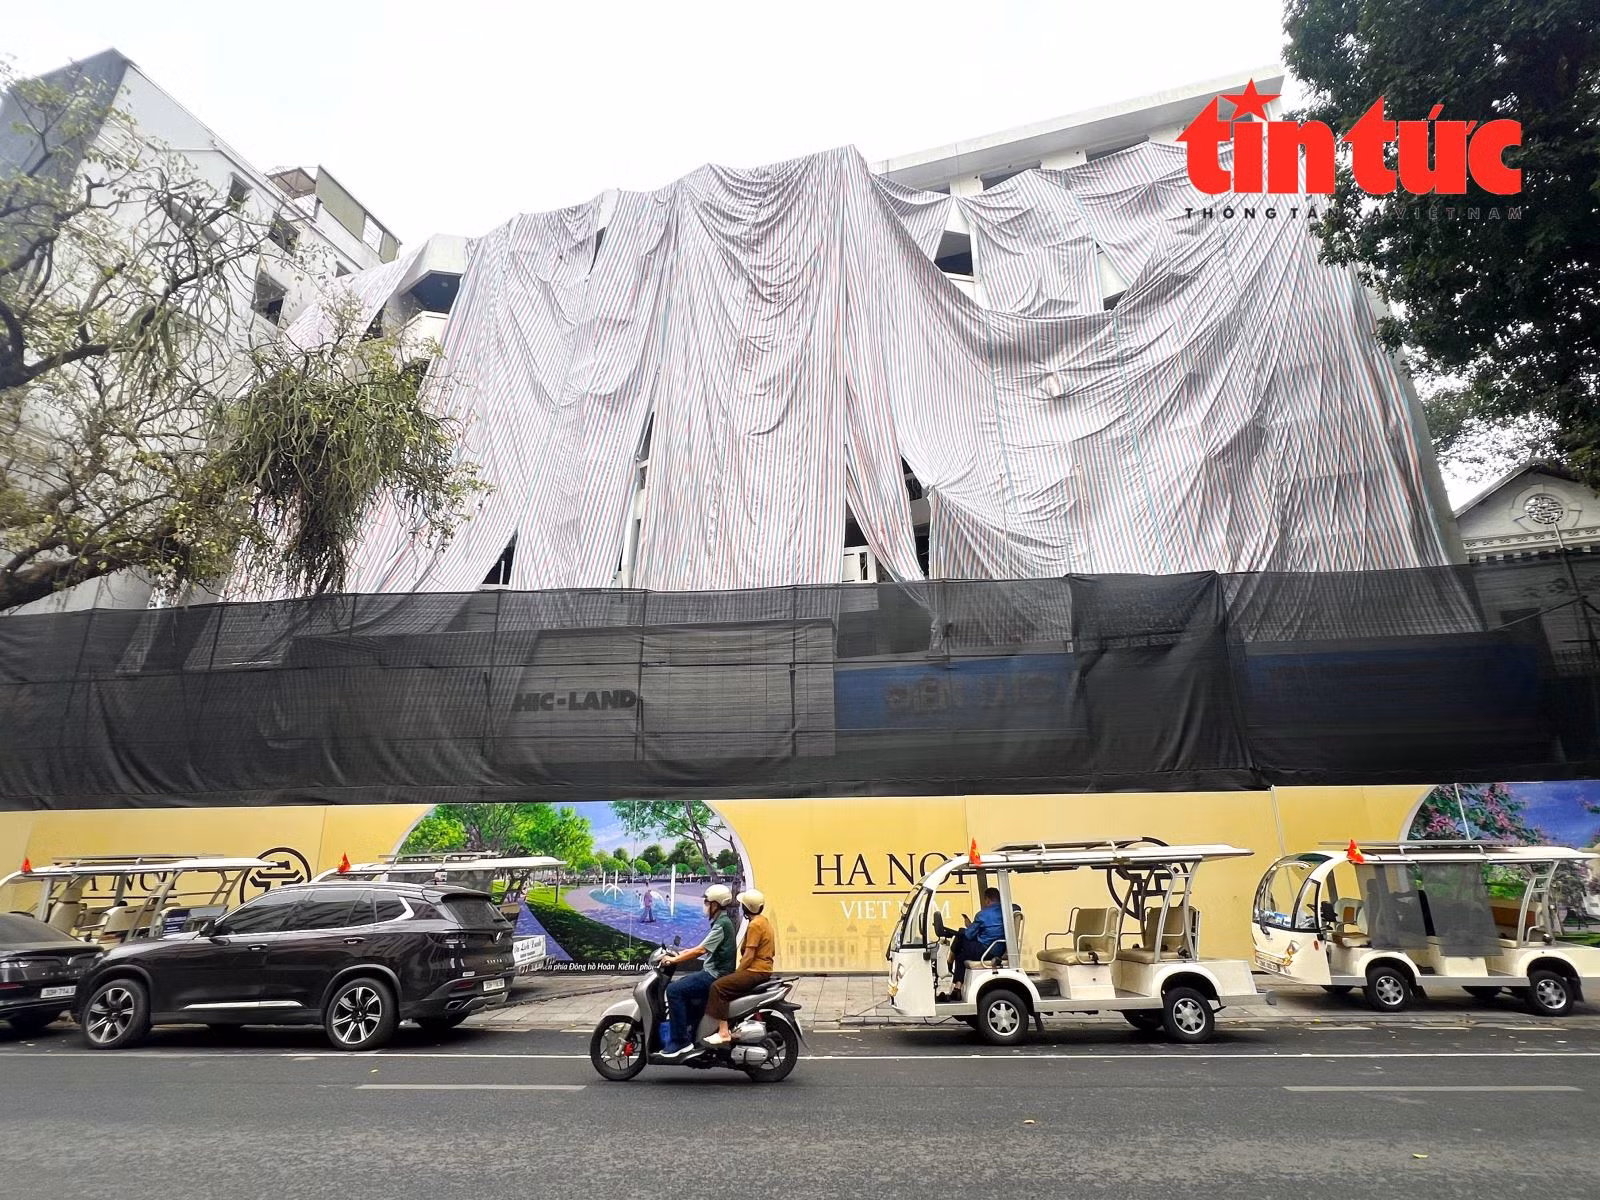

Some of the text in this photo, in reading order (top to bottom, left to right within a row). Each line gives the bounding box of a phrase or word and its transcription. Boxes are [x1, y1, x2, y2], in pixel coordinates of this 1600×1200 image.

[512, 690, 637, 711] HIC-LAND
[814, 853, 876, 886] HA
[840, 900, 892, 920] VIET
